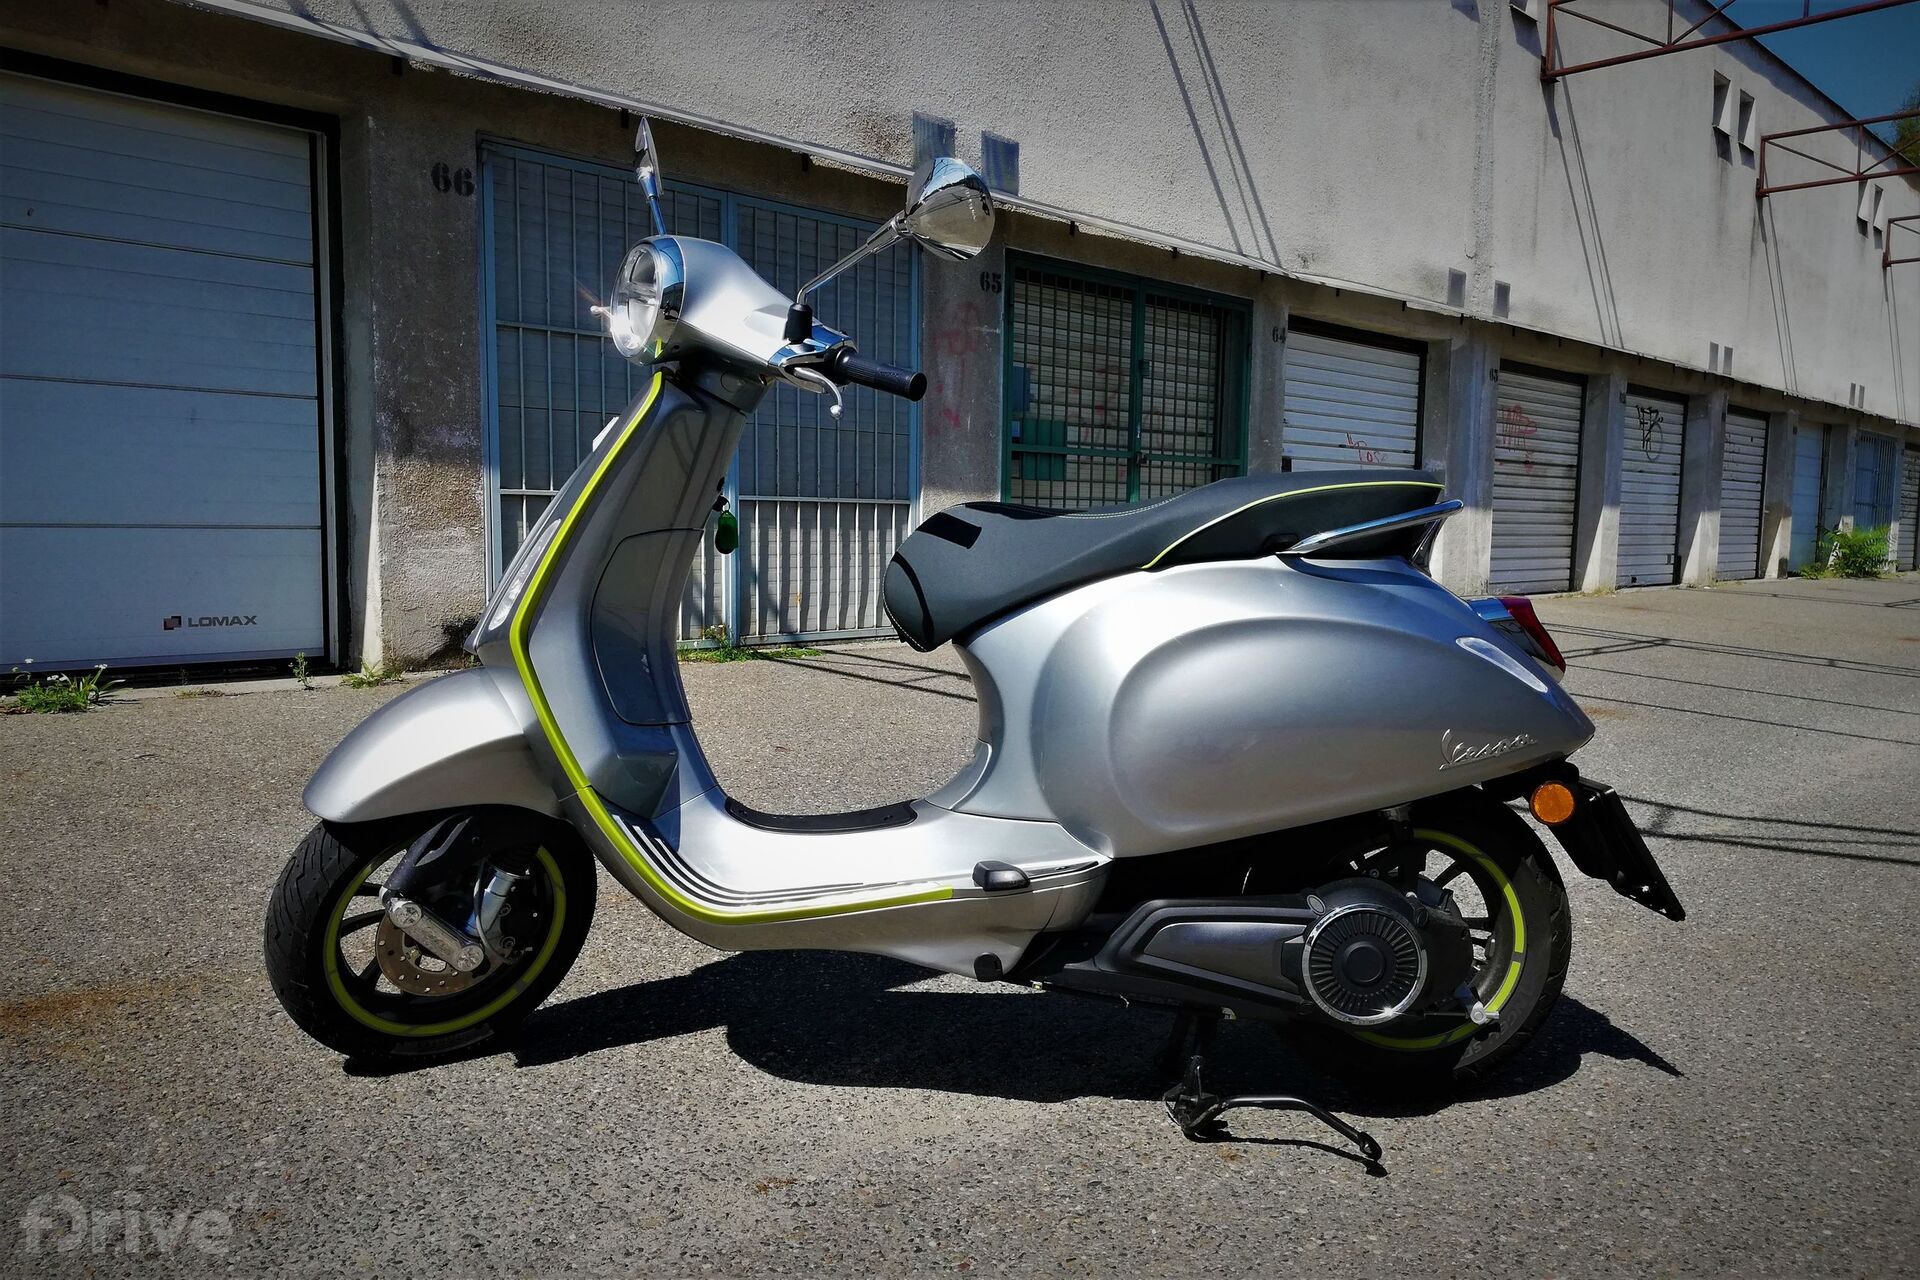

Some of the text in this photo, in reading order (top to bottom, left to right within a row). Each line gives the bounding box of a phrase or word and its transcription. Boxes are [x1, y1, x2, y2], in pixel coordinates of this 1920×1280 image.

[431, 162, 475, 197] 66
[979, 271, 1002, 294] 65
[187, 615, 258, 627] LOMAX
[1439, 728, 1538, 770] Vespa
